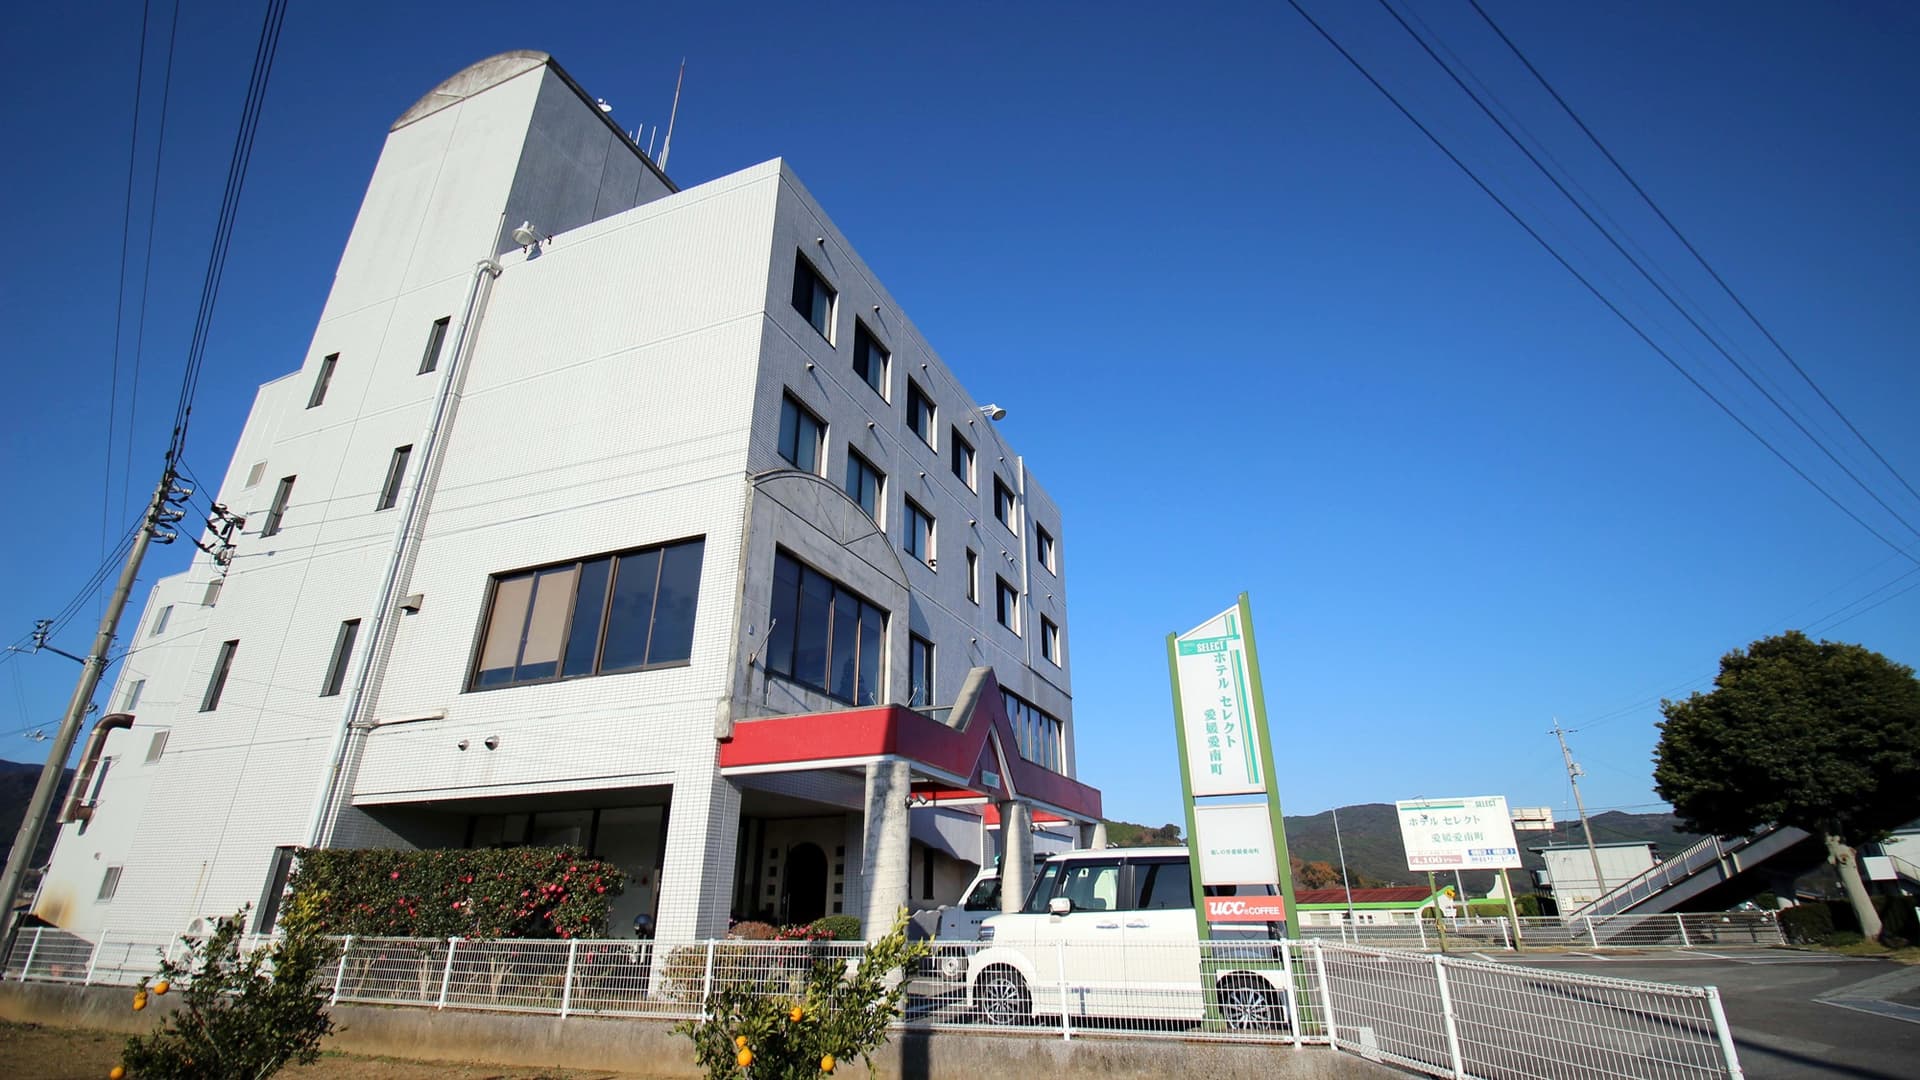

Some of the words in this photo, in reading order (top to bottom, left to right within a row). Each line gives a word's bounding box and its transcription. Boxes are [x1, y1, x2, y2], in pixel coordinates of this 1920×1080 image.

[1196, 641, 1224, 653] SELECT
[1213, 652, 1229, 690] ホテル
[1220, 695, 1236, 748] セレクト
[1204, 708, 1222, 775] 愛媛愛南町
[1475, 800, 1496, 808] SELECT
[1409, 816, 1438, 826] ホテル
[1442, 815, 1481, 826] セレクト
[1209, 901, 1246, 916] UCC
[1248, 906, 1281, 915] COFFEE
